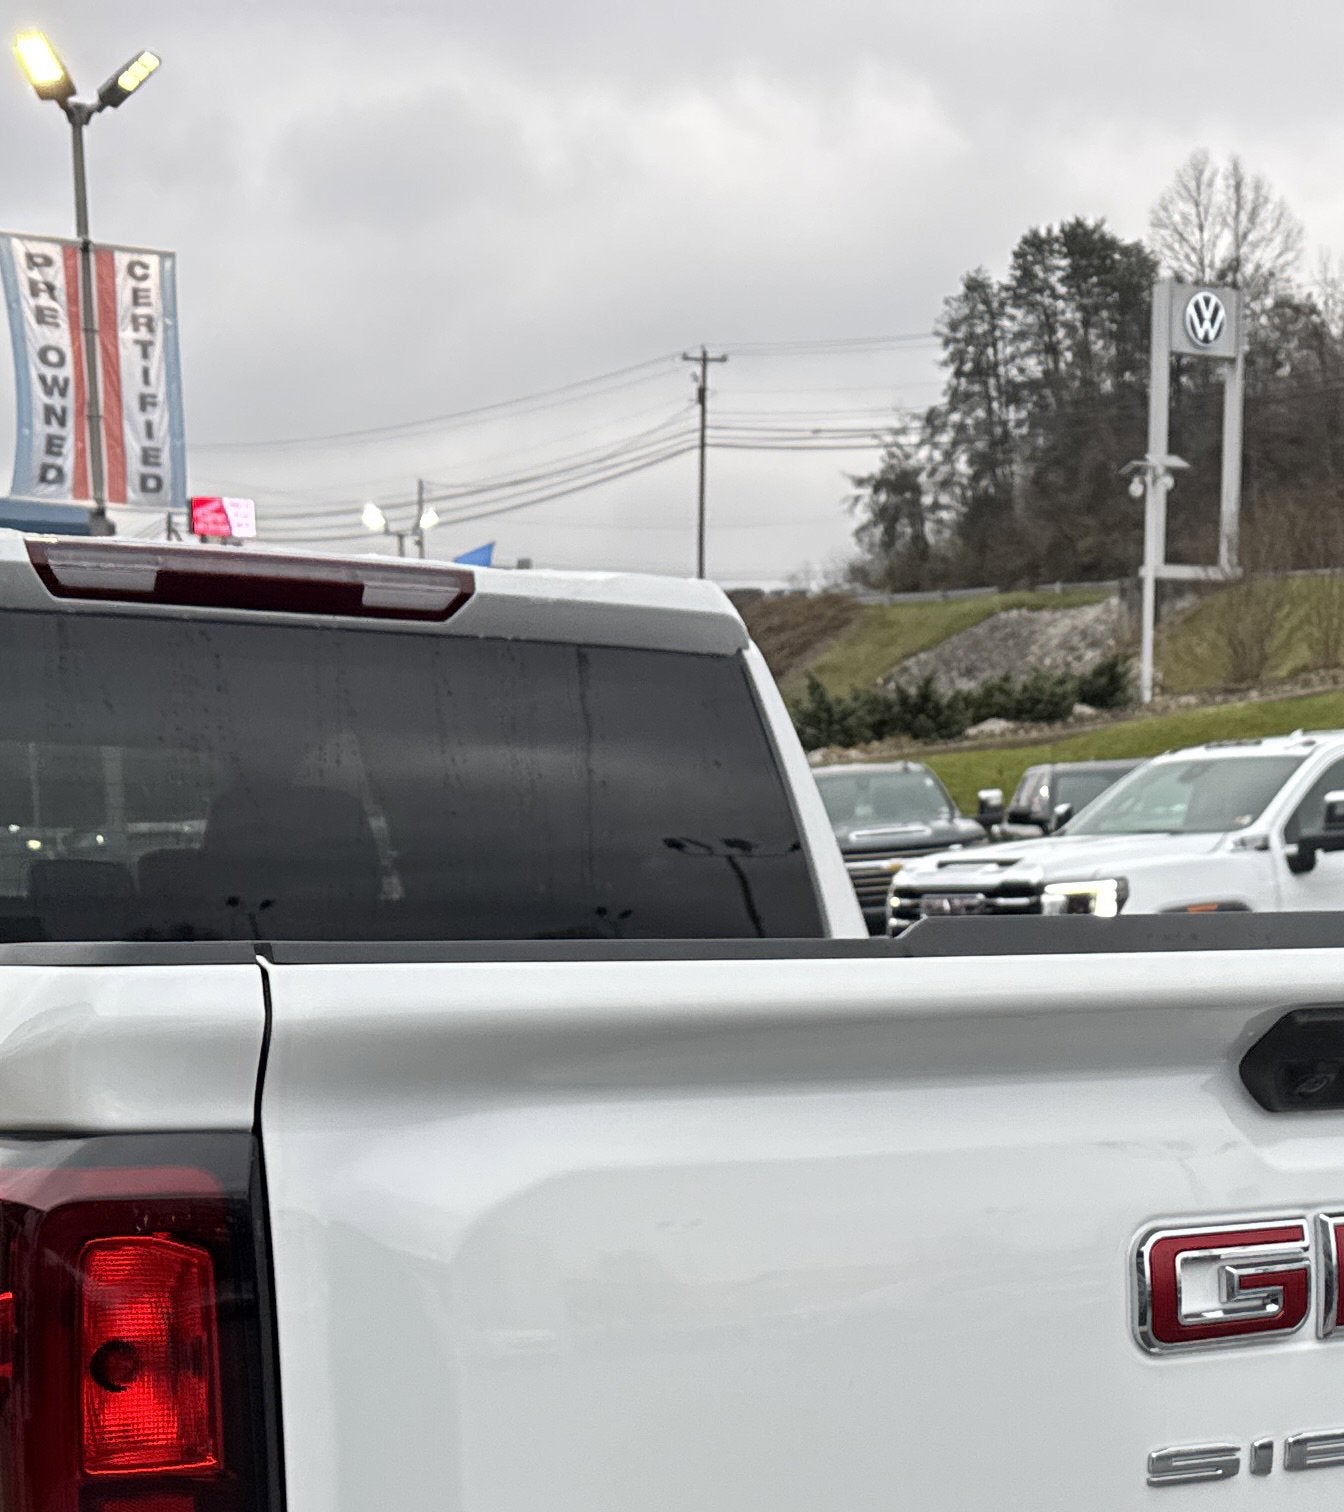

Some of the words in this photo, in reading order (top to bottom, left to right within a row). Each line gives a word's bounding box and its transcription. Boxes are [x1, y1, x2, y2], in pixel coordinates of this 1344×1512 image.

[25, 252, 60, 328] PRE
[37, 346, 71, 486] OWNED
[127, 260, 163, 493] CERTIFIED
